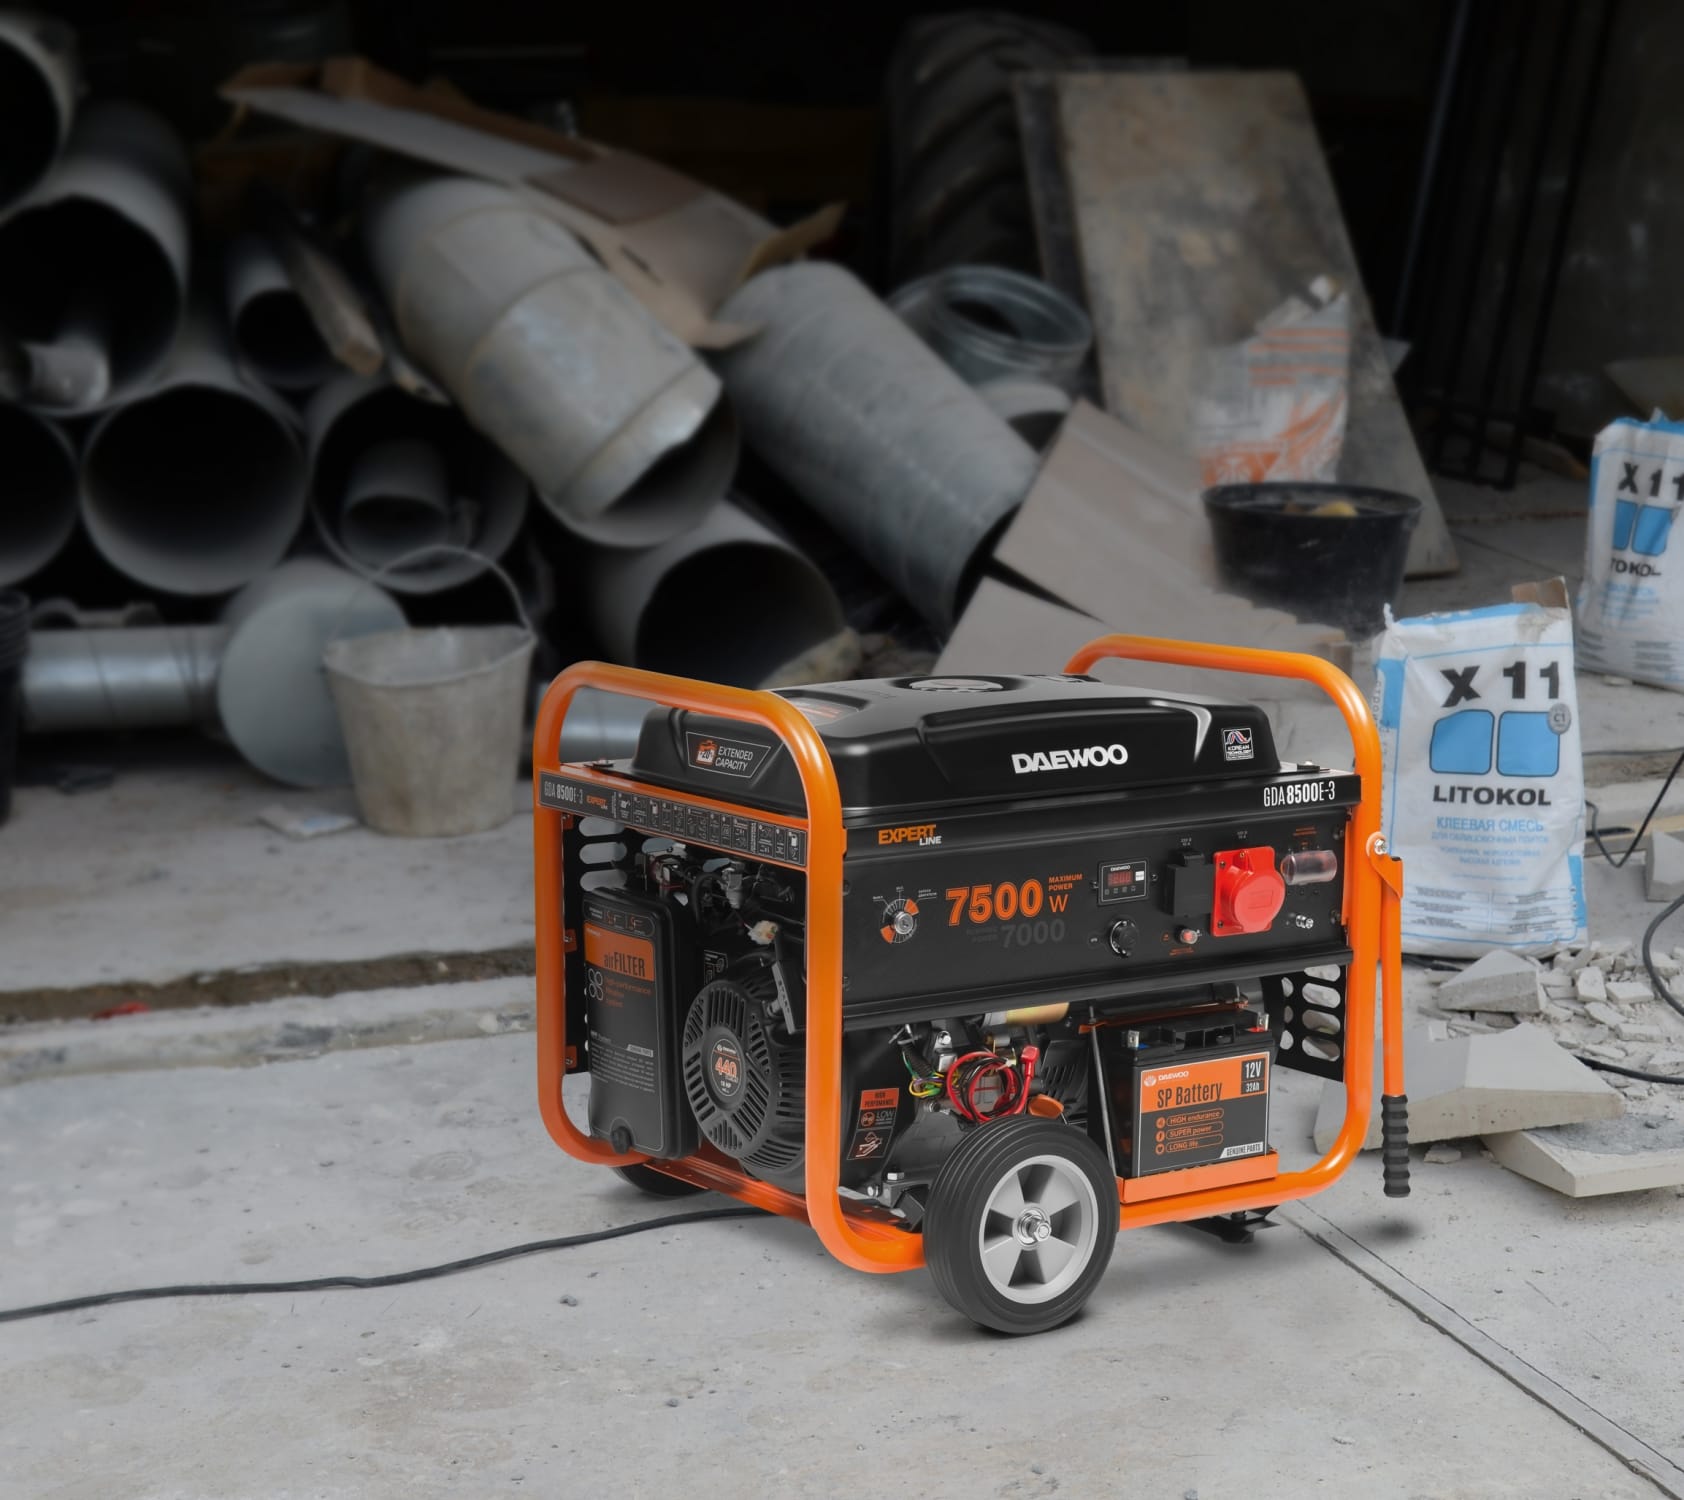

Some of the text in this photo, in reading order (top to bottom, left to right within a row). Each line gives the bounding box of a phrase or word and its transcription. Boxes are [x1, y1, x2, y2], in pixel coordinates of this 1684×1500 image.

[1618, 462, 1638, 494] X
[1440, 661, 1560, 708] X 11
[718, 746, 754, 761] EXTENDED
[1011, 744, 1128, 774] DAEWOO
[715, 757, 749, 771] CAPACITY
[586, 795, 608, 807] EXPERT
[1433, 785, 1551, 806] LITOKOL
[1436, 816, 1545, 833] КЛЕЕВАЯ СМЕСЬ
[878, 824, 937, 845] EXPERT
[919, 836, 942, 847] LINE
[1048, 873, 1083, 884] MAXIMUM
[1048, 882, 1073, 891] POWER
[945, 878, 1044, 927] 7500
[1049, 894, 1069, 913] W
[1001, 918, 1066, 949] 7000
[603, 952, 646, 978] airFILTER
[715, 1056, 738, 1079] 440
[1158, 1070, 1190, 1081] DAEWOO
[1245, 1061, 1262, 1079] 12V
[1157, 1082, 1223, 1108] SP Battery
[1170, 1111, 1221, 1125] HIGH endurance
[1169, 1126, 1212, 1138] SUPER power
[1168, 1141, 1187, 1151] LONG
[1226, 1143, 1261, 1156] GENUINE PARTS
